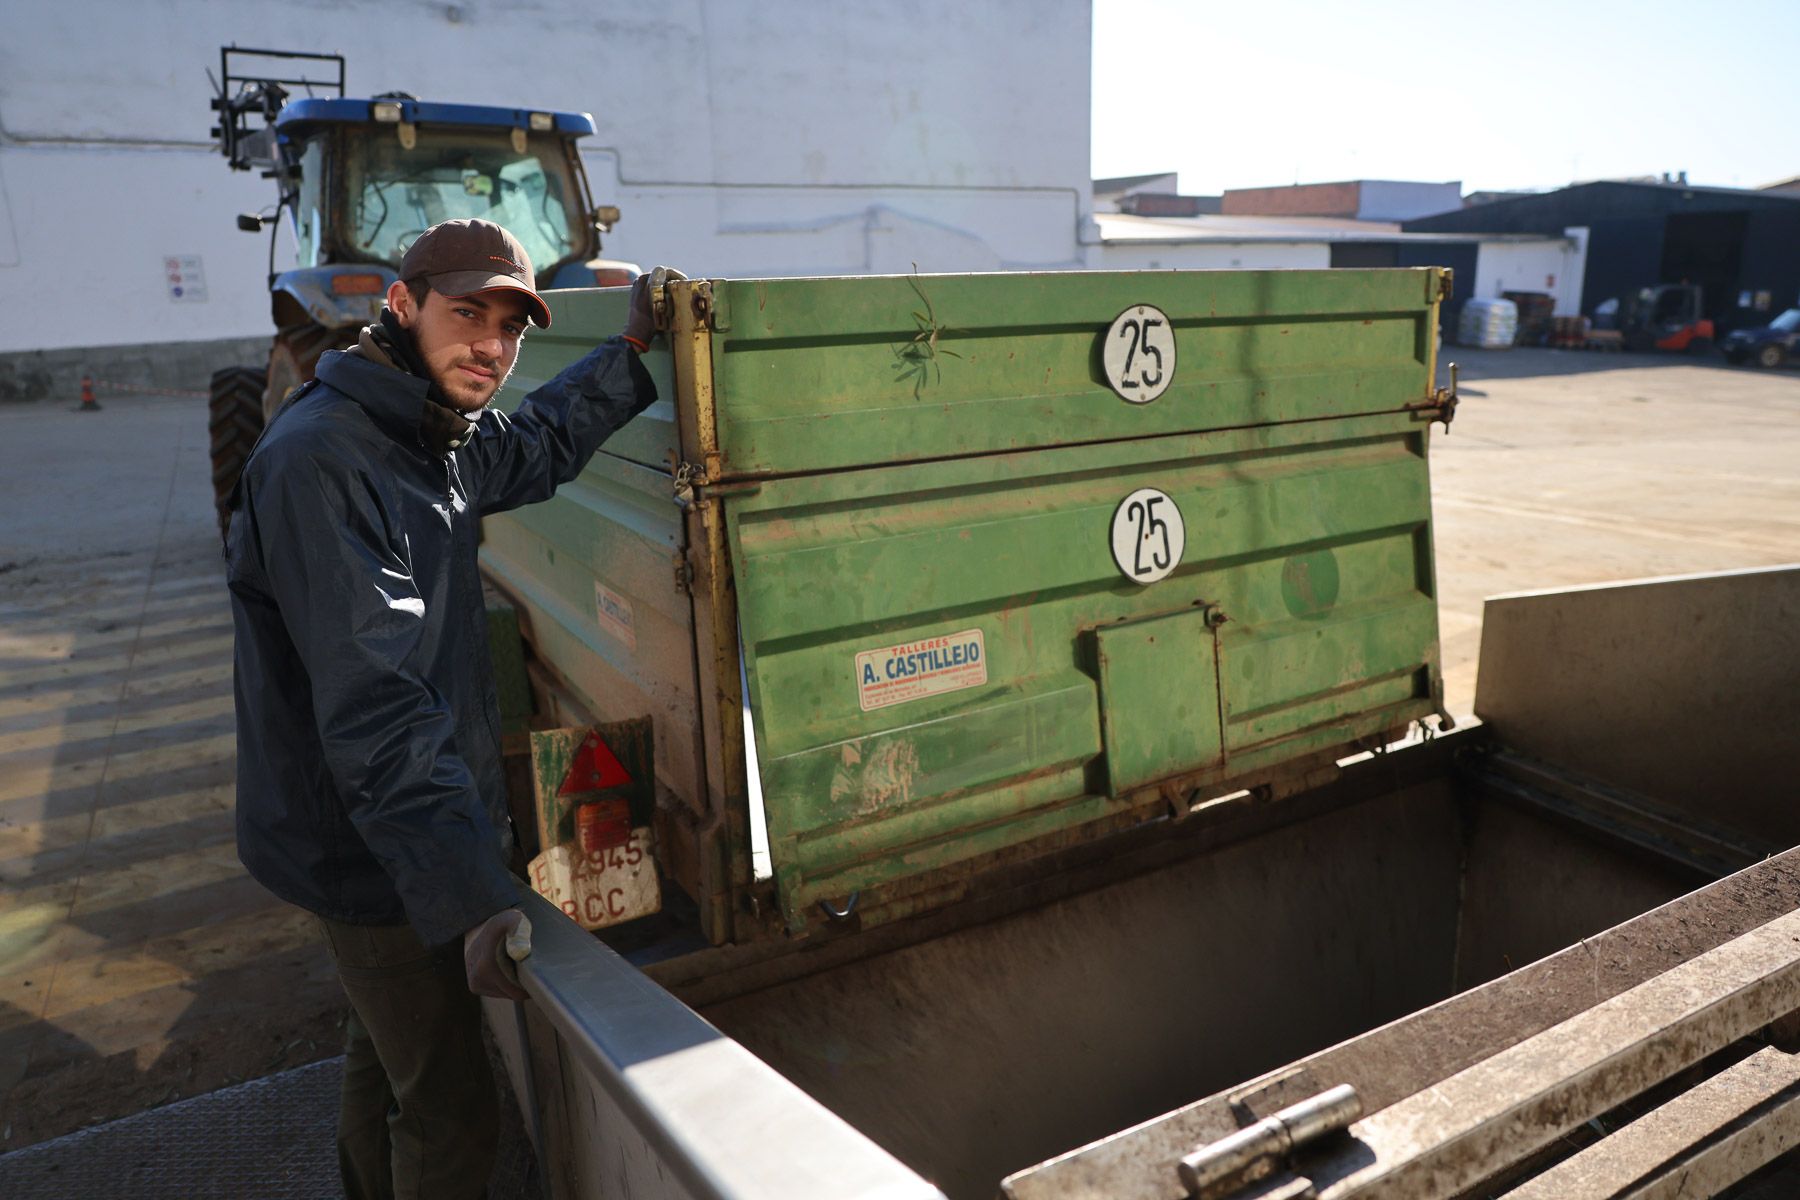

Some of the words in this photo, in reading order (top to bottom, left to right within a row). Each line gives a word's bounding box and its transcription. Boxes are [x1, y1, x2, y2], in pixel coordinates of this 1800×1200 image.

[1119, 318, 1162, 388] 25
[1127, 496, 1171, 576] 25
[863, 663, 880, 685] A.
[885, 642, 979, 679] CASTILLEJO
[891, 638, 949, 656] TALLERES
